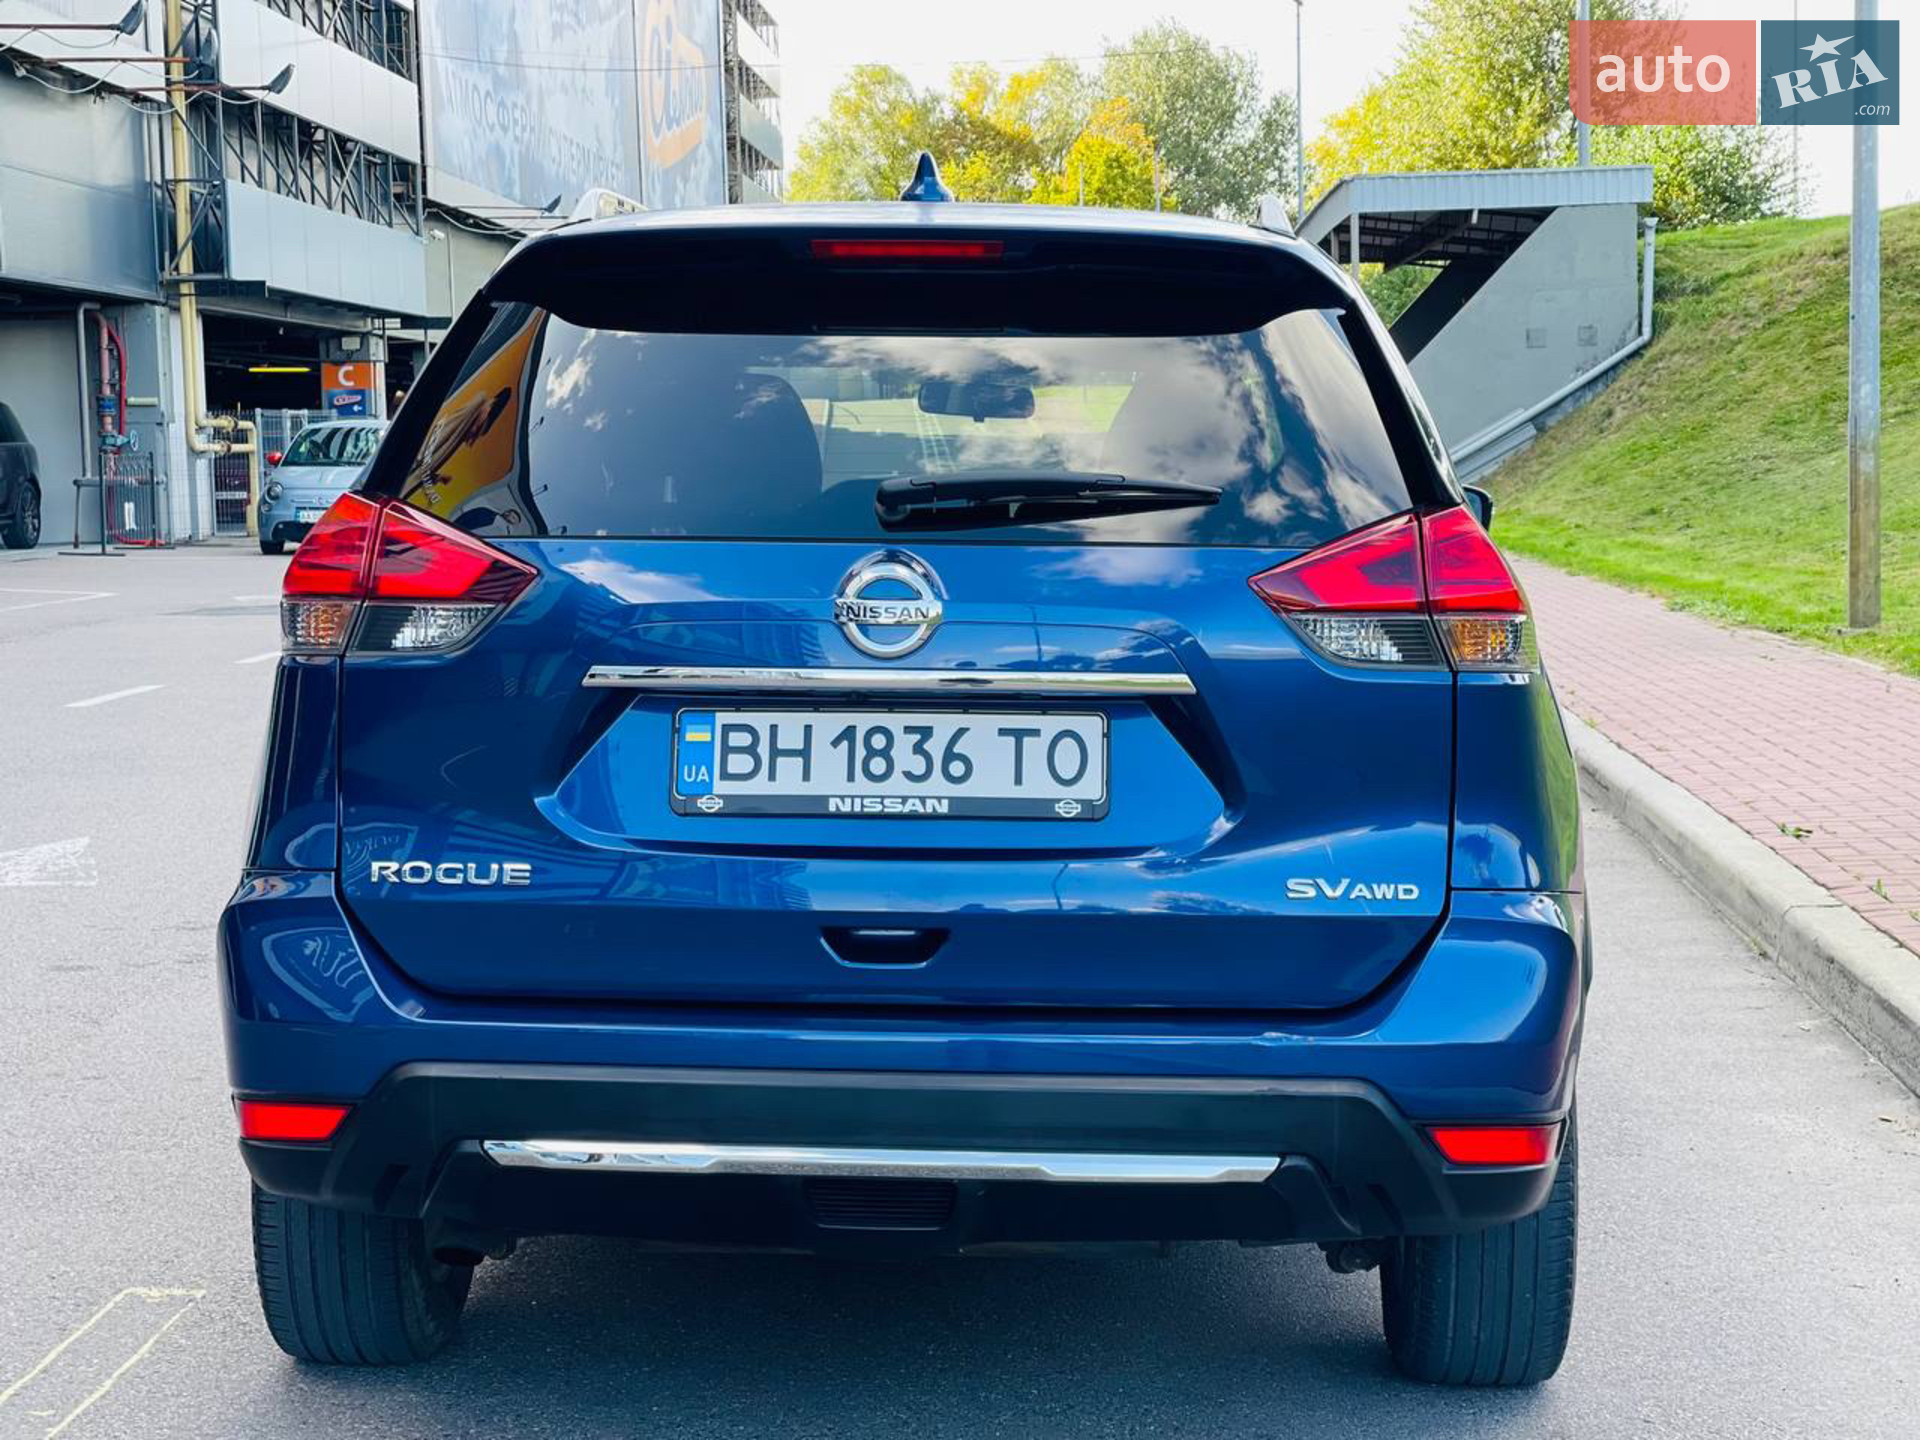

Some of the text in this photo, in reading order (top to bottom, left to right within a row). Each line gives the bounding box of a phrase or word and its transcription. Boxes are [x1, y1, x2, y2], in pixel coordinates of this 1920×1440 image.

[338, 365, 355, 386] C
[846, 605, 930, 619] NISSAN
[719, 723, 1089, 787] BH 1836 TO
[684, 765, 709, 782] UA
[828, 797, 949, 813] NISSAN
[371, 861, 532, 886] ROGUE
